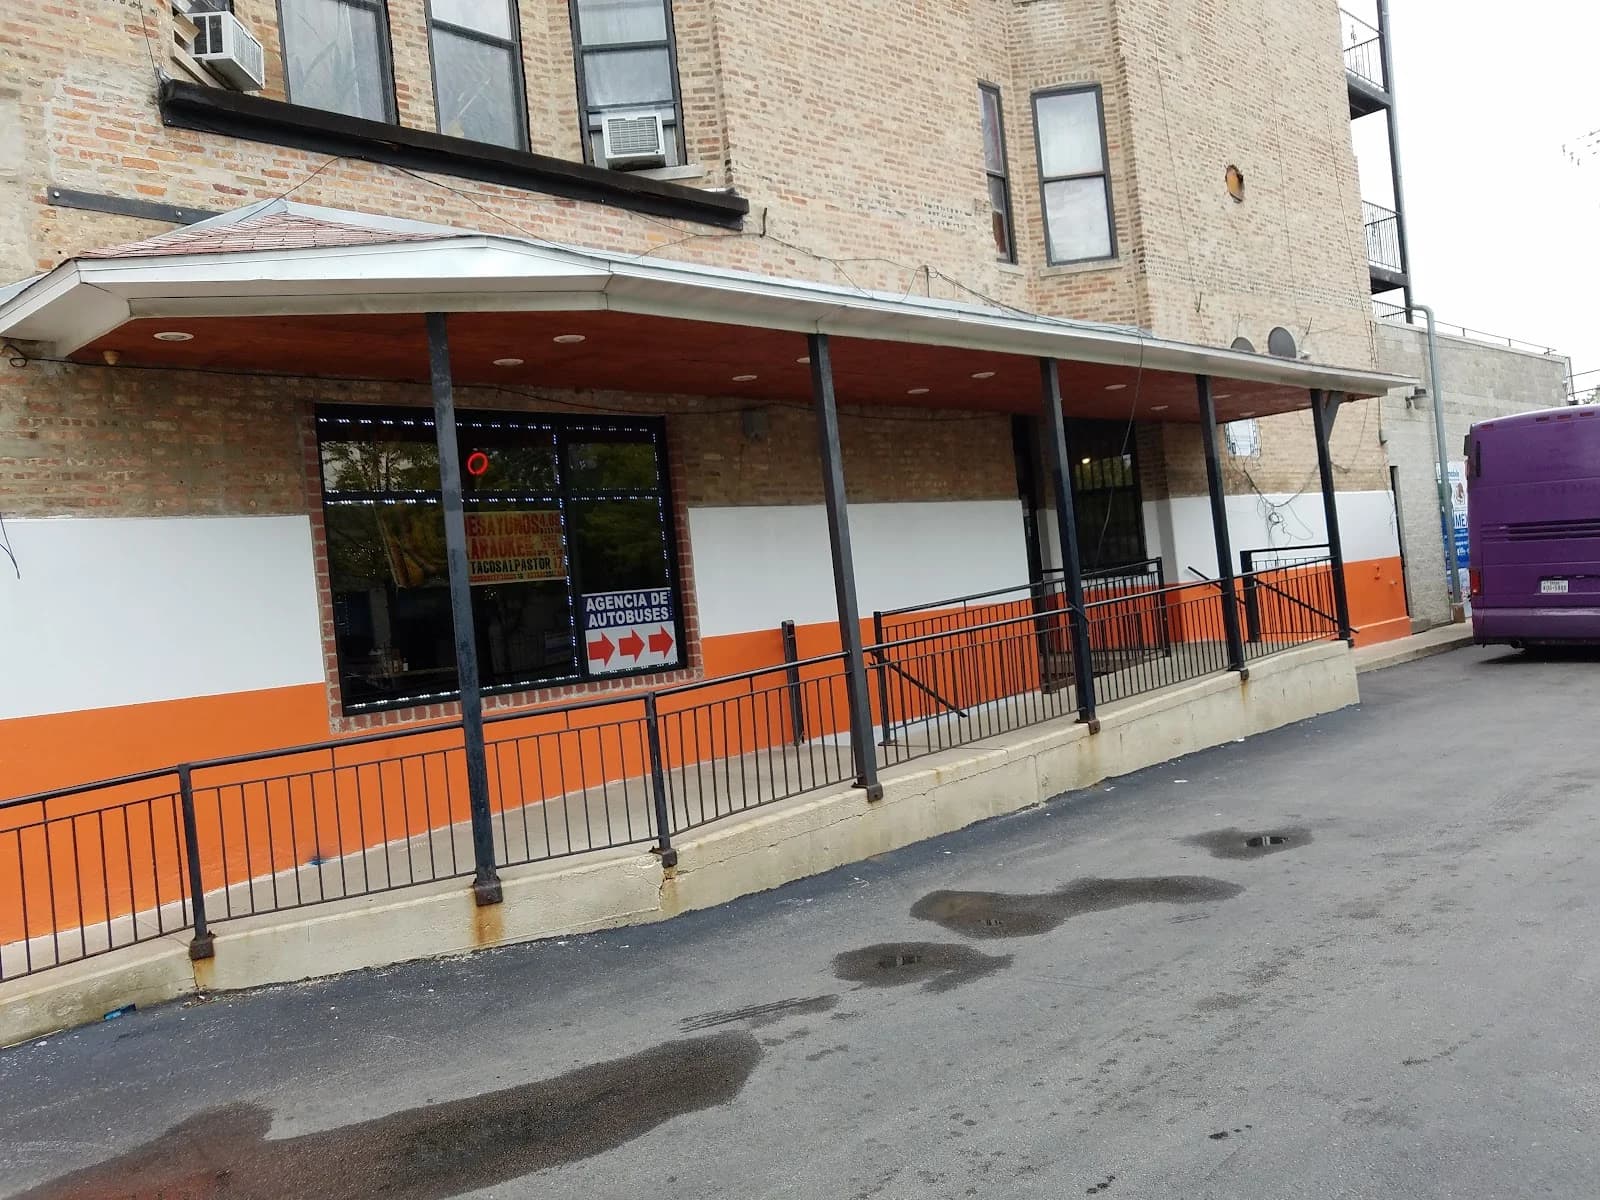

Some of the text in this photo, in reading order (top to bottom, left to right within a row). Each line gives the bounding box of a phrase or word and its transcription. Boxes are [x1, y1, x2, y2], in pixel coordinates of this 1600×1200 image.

[465, 513, 539, 536] ESAYUNOS
[467, 537, 525, 560] ARAOKE
[586, 591, 668, 612] AGENCIA DE
[588, 606, 669, 628] AUTOBUSES
